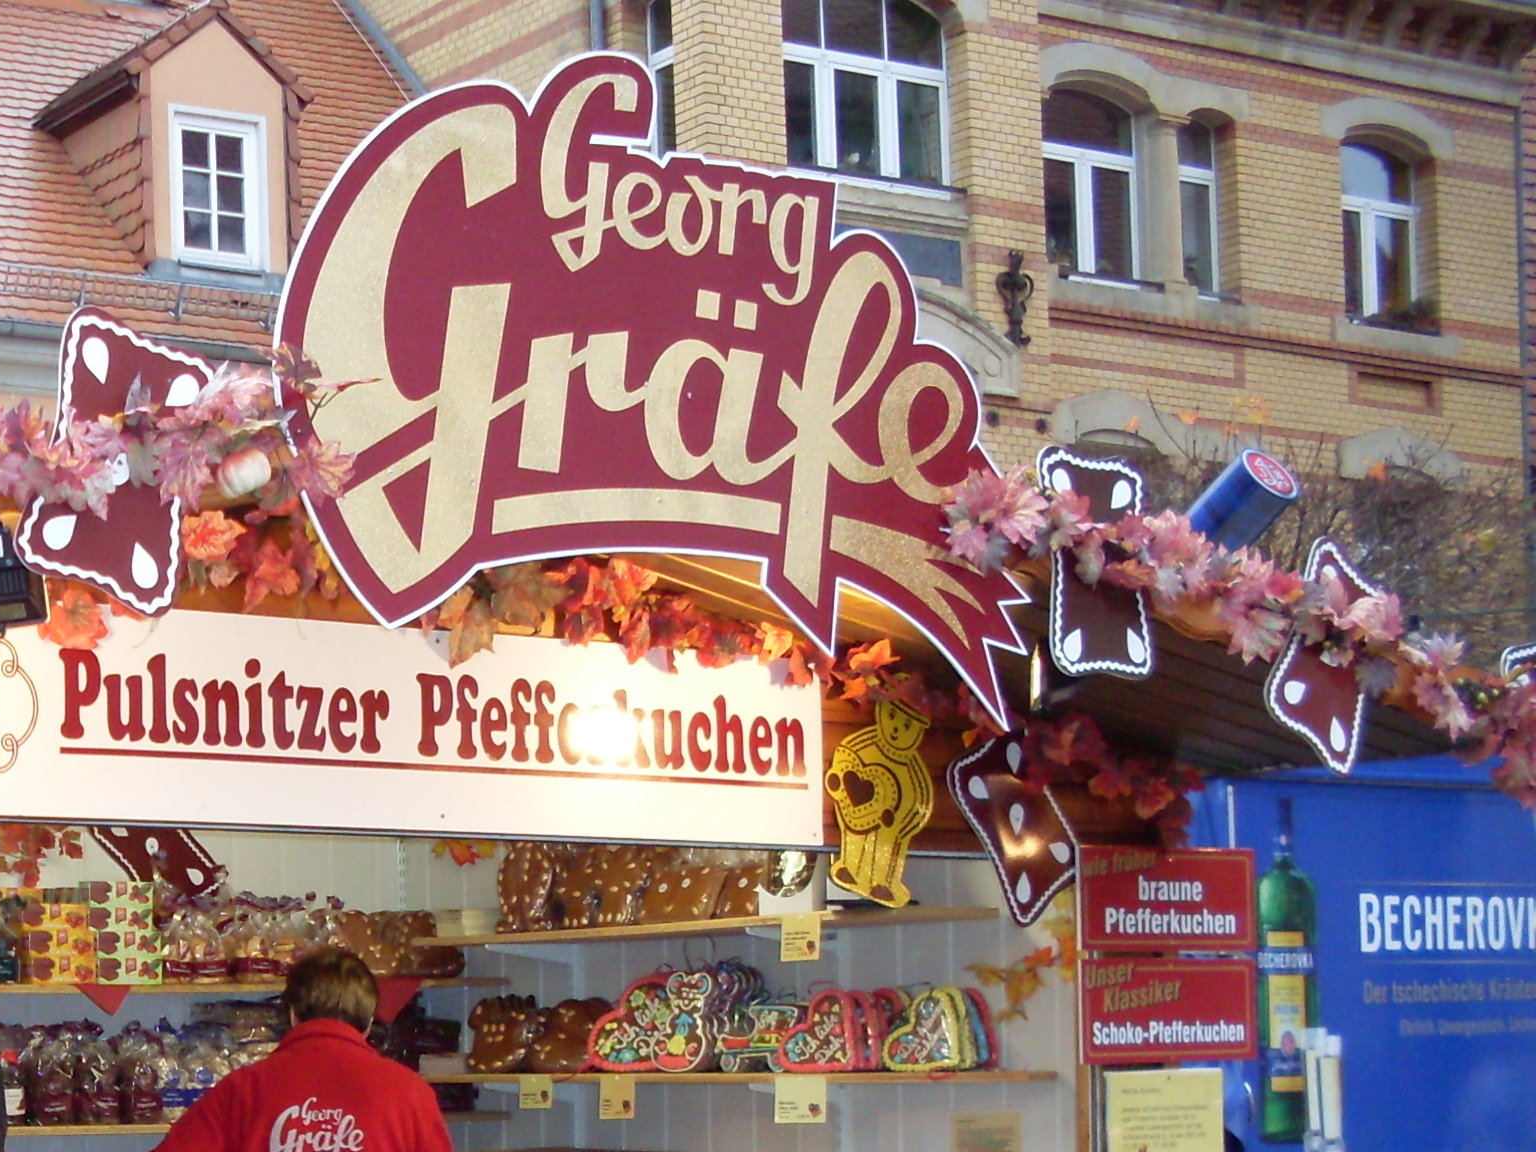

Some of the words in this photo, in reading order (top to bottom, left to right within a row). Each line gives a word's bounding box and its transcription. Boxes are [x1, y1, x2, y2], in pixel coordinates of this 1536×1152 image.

[541, 73, 818, 305] Georg
[302, 103, 972, 607] Gräfe
[61, 648, 389, 754] Pulsnitzer
[417, 671, 807, 778] Pfeffekuchen
[1083, 856, 1108, 877] wie
[1138, 875, 1203, 902] braune
[1104, 907, 1237, 934] Pfefferkuchen
[1086, 962, 1135, 989] Unser
[1103, 979, 1182, 1014] Klassiker
[1092, 1019, 1245, 1046] Schoko-Pfefferkuchen
[301, 1097, 343, 1126] Georg
